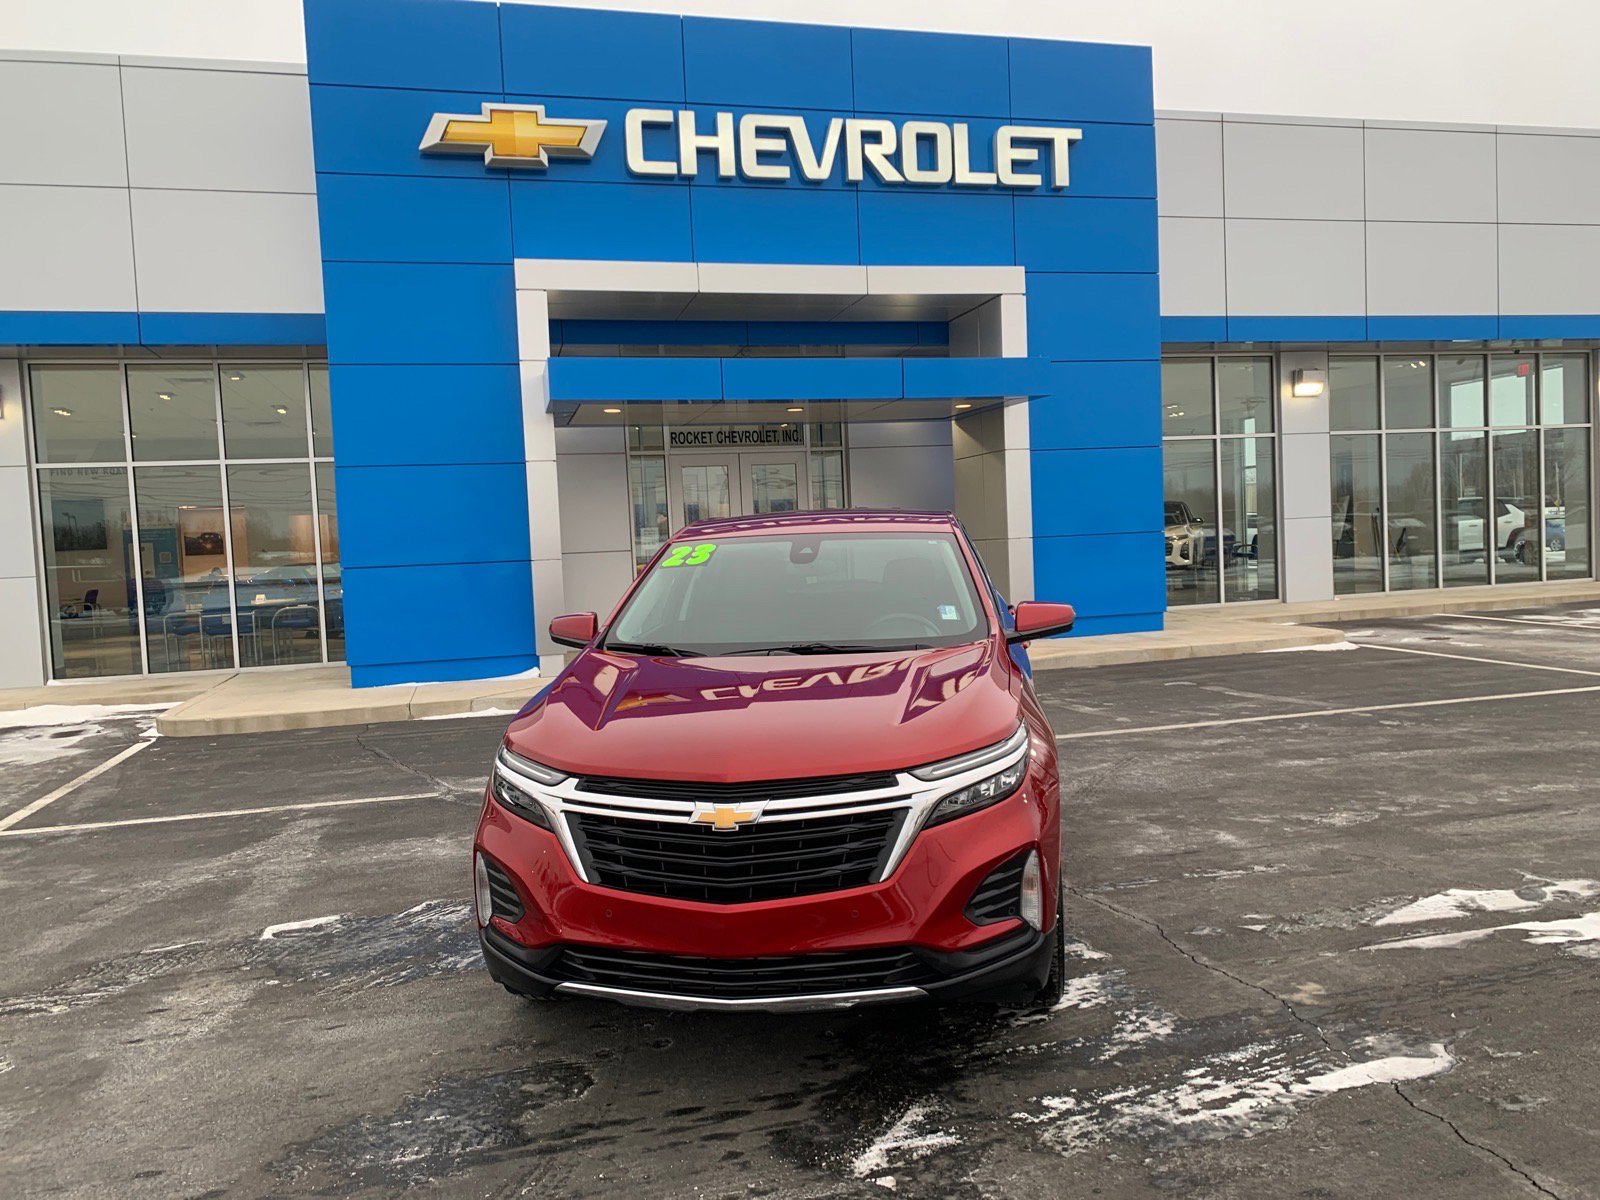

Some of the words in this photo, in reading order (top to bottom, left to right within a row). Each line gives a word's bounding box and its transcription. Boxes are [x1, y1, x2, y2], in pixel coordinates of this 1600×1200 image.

[625, 107, 1083, 190] CHEVROLET
[670, 431, 714, 445] ROCKET
[716, 429, 780, 445] CHEVROLET,
[782, 429, 802, 442] INC.
[103, 467, 128, 476] ROAD
[661, 543, 717, 568] 23
